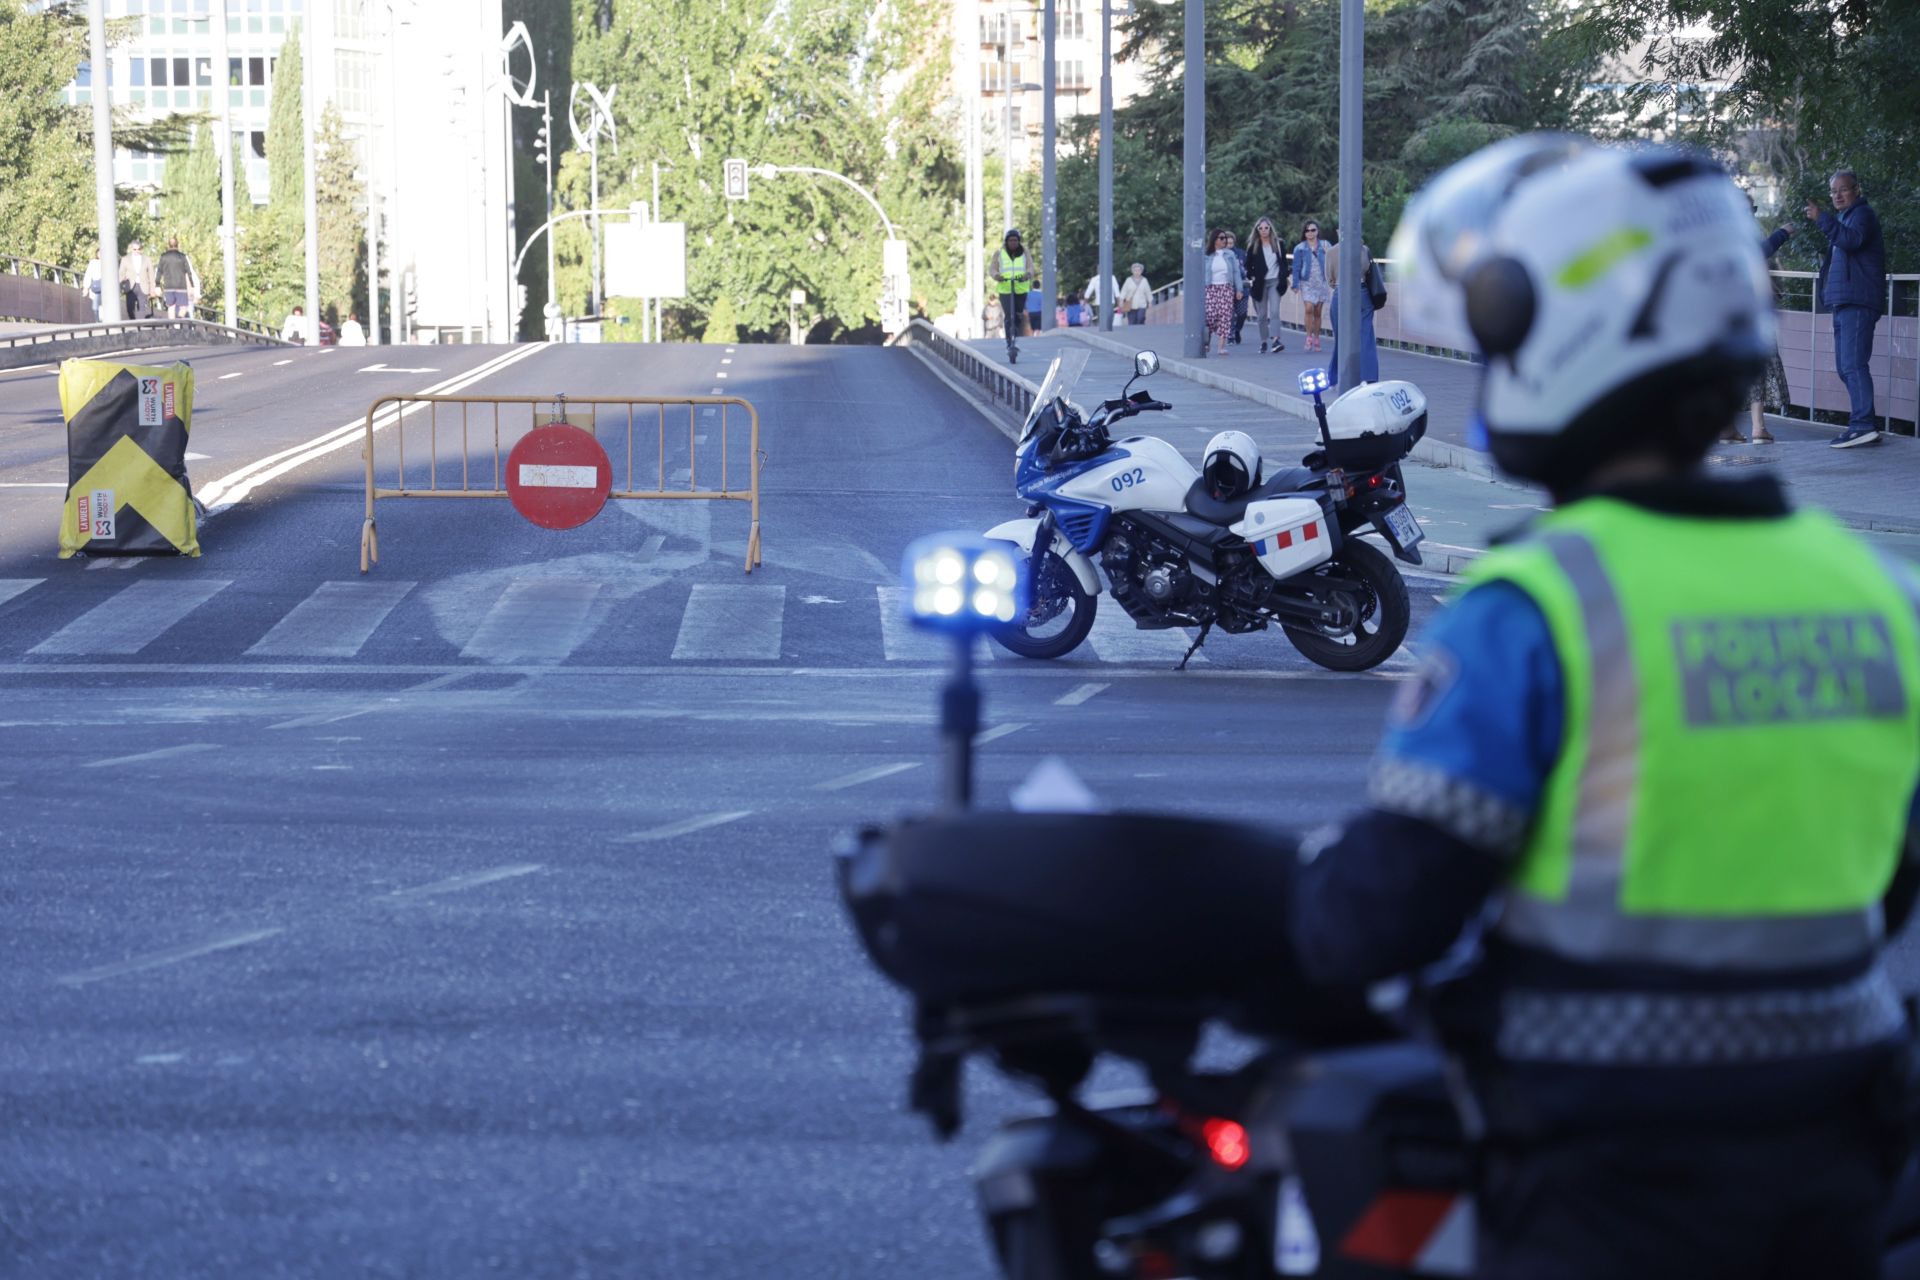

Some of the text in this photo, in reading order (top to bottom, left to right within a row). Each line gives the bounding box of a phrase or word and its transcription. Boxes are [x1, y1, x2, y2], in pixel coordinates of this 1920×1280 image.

[165, 393, 173, 416] VUELTA
[1391, 389, 1411, 410] 092
[1111, 467, 1147, 492] 092
[79, 499, 88, 522] VUELTA
